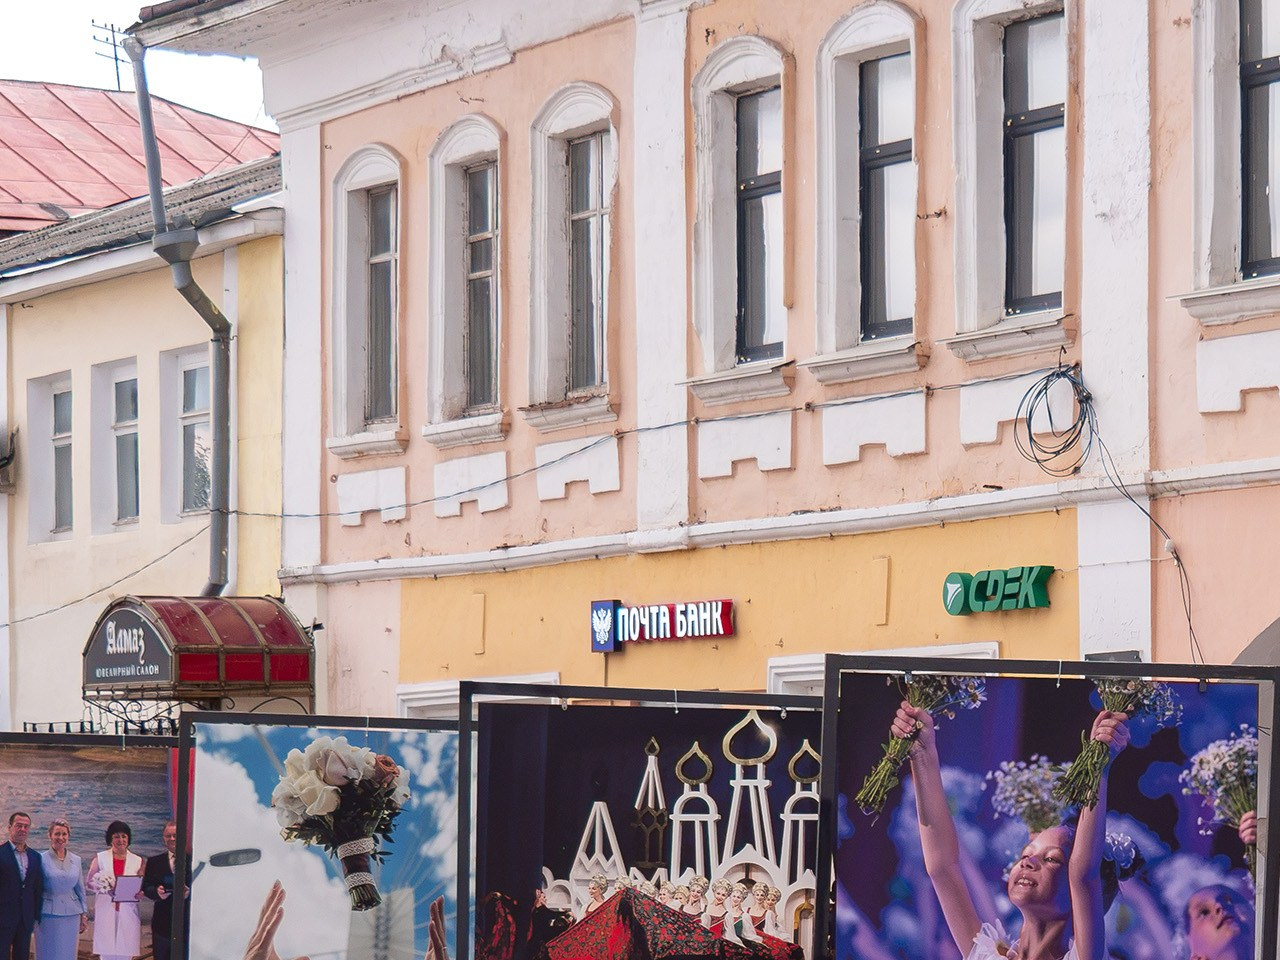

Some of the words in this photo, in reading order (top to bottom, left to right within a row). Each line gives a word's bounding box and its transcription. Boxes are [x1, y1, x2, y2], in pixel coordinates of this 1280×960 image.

[617, 604, 671, 641] ПОЧТА
[676, 601, 724, 638] БАНК
[106, 620, 145, 664] Алмаз
[96, 665, 136, 678] ЮВЕЛИРНЫЙ
[136, 664, 159, 676] САЛОН
